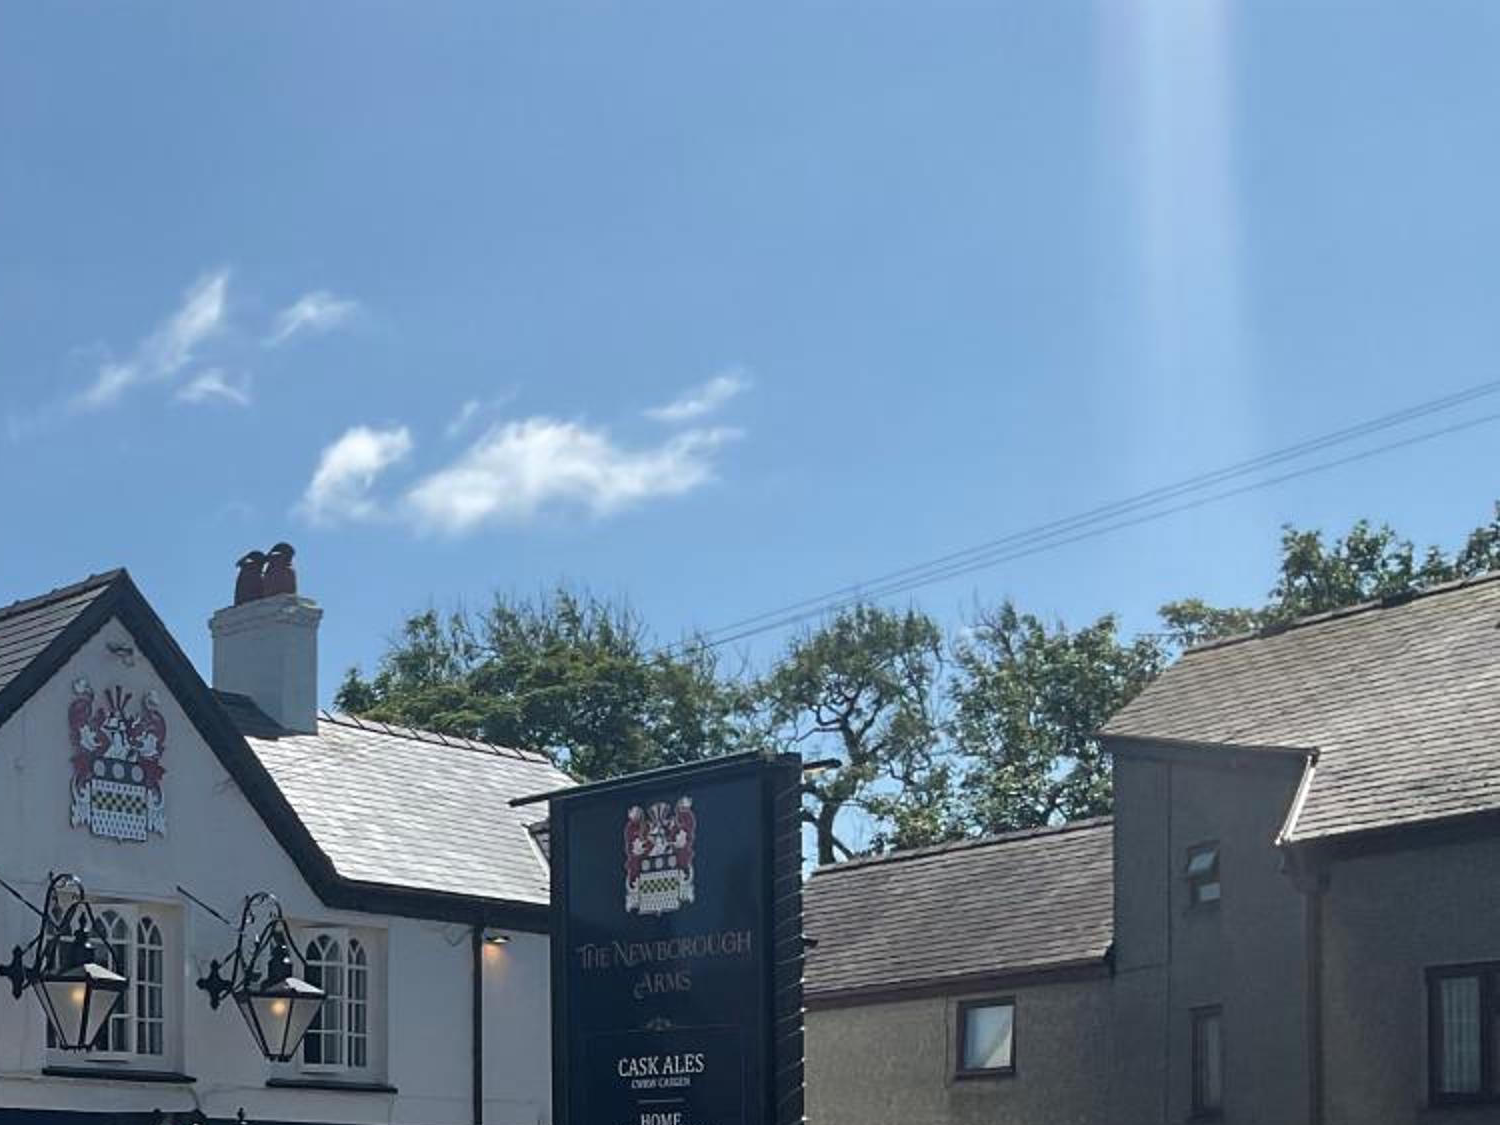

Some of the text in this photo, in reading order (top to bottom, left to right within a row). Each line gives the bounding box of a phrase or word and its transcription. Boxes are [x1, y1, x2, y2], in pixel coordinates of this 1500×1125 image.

[579, 930, 752, 970] THE NEWBOROUGH
[633, 972, 692, 999] ARMS
[617, 1053, 705, 1077] CASK ALES
